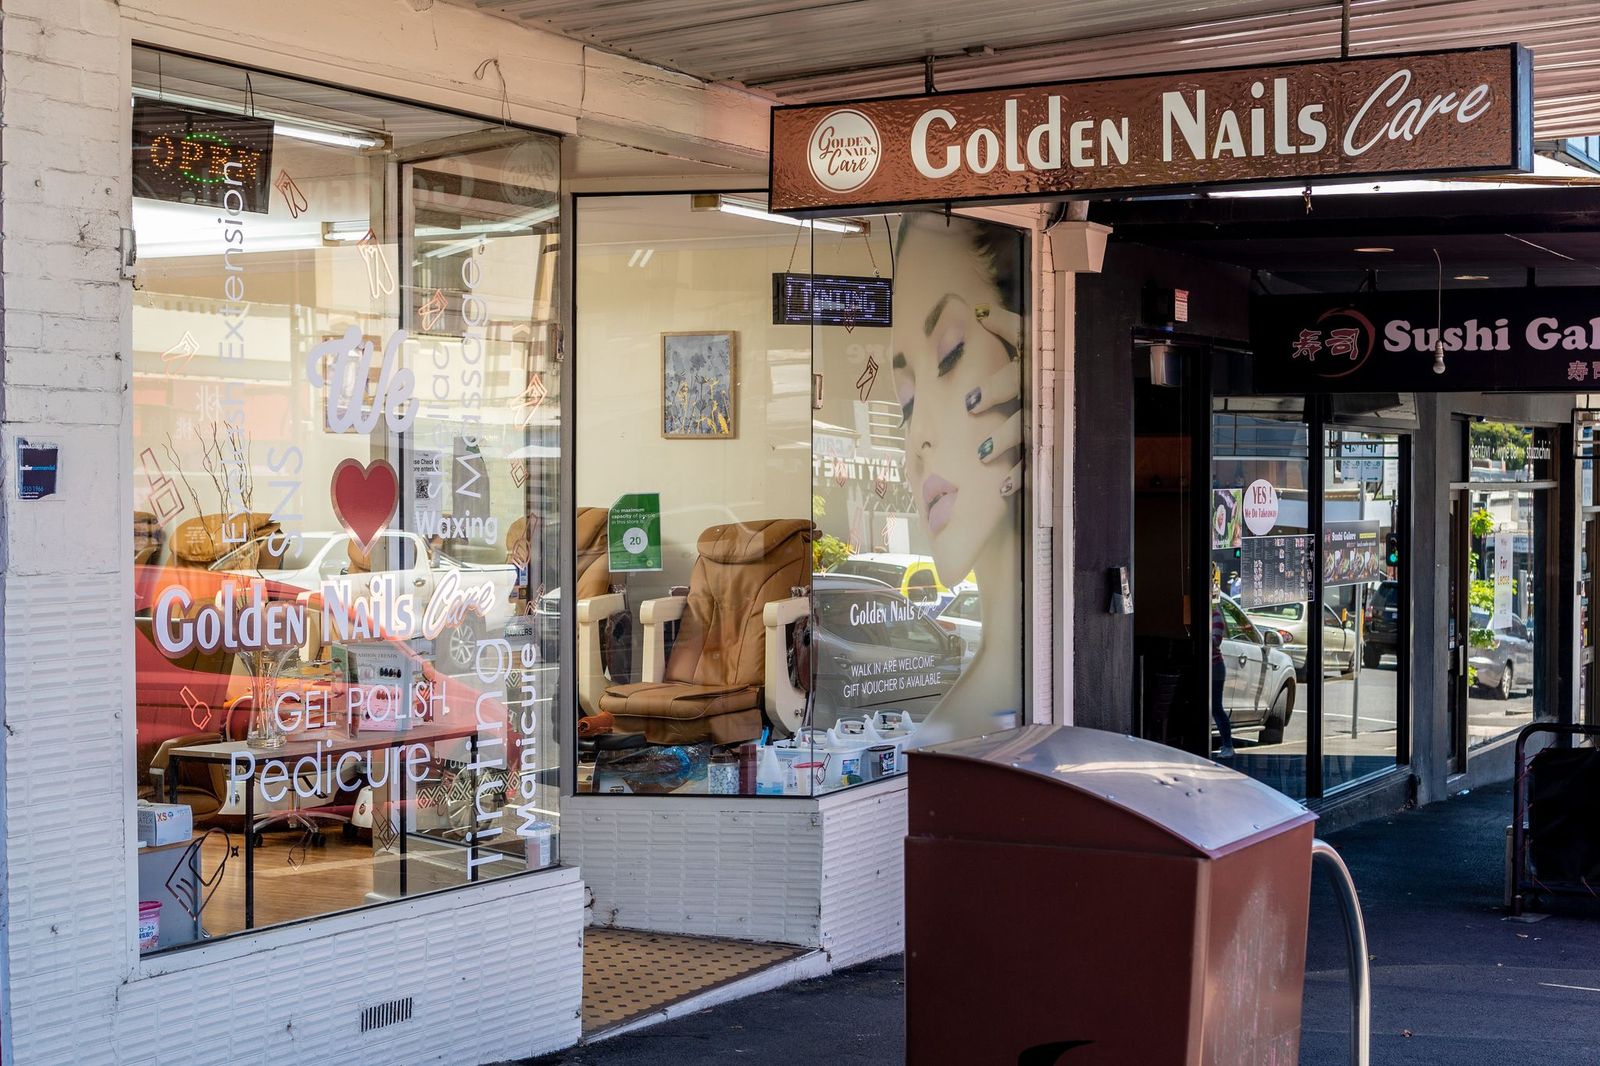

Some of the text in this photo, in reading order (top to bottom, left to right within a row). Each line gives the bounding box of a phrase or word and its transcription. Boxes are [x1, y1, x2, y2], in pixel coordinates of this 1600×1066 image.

[1342, 68, 1492, 157] Care
[150, 136, 260, 180] OPEN
[827, 148, 869, 176] Care
[218, 161, 244, 364] Extension
[1292, 327, 1360, 362] 寿司
[1383, 318, 1510, 352] Sushi
[305, 324, 421, 434] We
[455, 257, 488, 498] Massage
[267, 446, 304, 558] SNS
[1245, 508, 1252, 517] We
[1252, 486, 1266, 504] YES
[416, 509, 498, 545] Waxing
[629, 536, 641, 545] 20
[424, 571, 494, 638] Care
[843, 672, 941, 698] GIFT VOUCHER IS AVAILABLE
[851, 655, 935, 677] WALK IN ARE WELCOME
[274, 690, 337, 732] GEL
[465, 638, 513, 880] Tinting
[515, 643, 536, 836] Manicure
[230, 738, 431, 808] Pedicure
